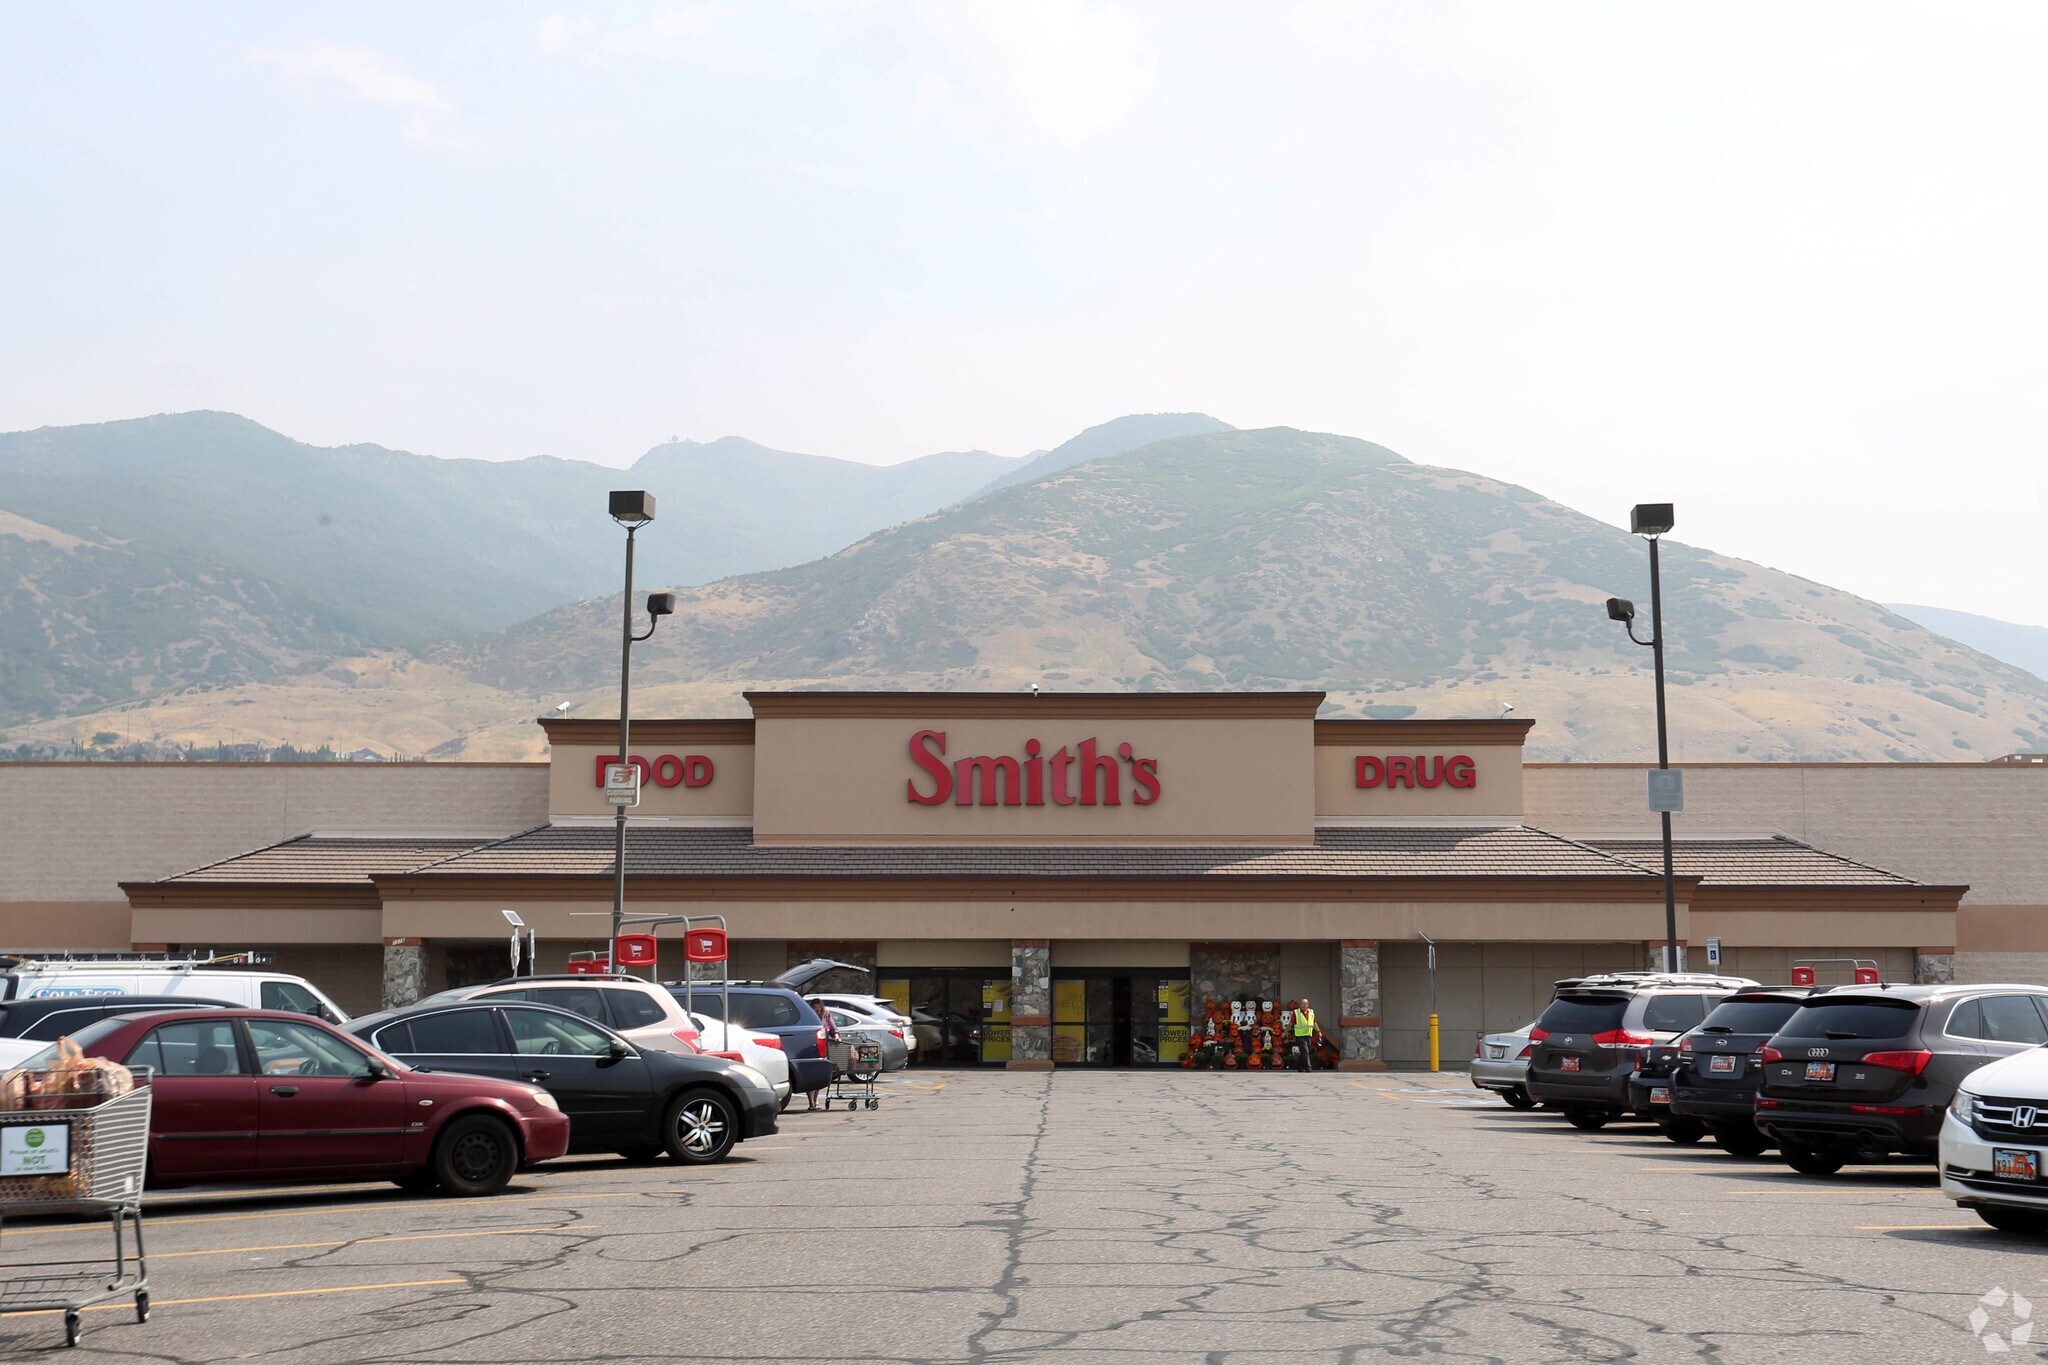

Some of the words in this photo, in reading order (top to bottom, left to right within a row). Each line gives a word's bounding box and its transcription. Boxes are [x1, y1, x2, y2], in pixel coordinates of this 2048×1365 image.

[907, 729, 1161, 805] Smith's
[1355, 755, 1476, 788] DRUG
[1066, 991, 1084, 1000] SAY
[23, 1155, 46, 1164] NOT
